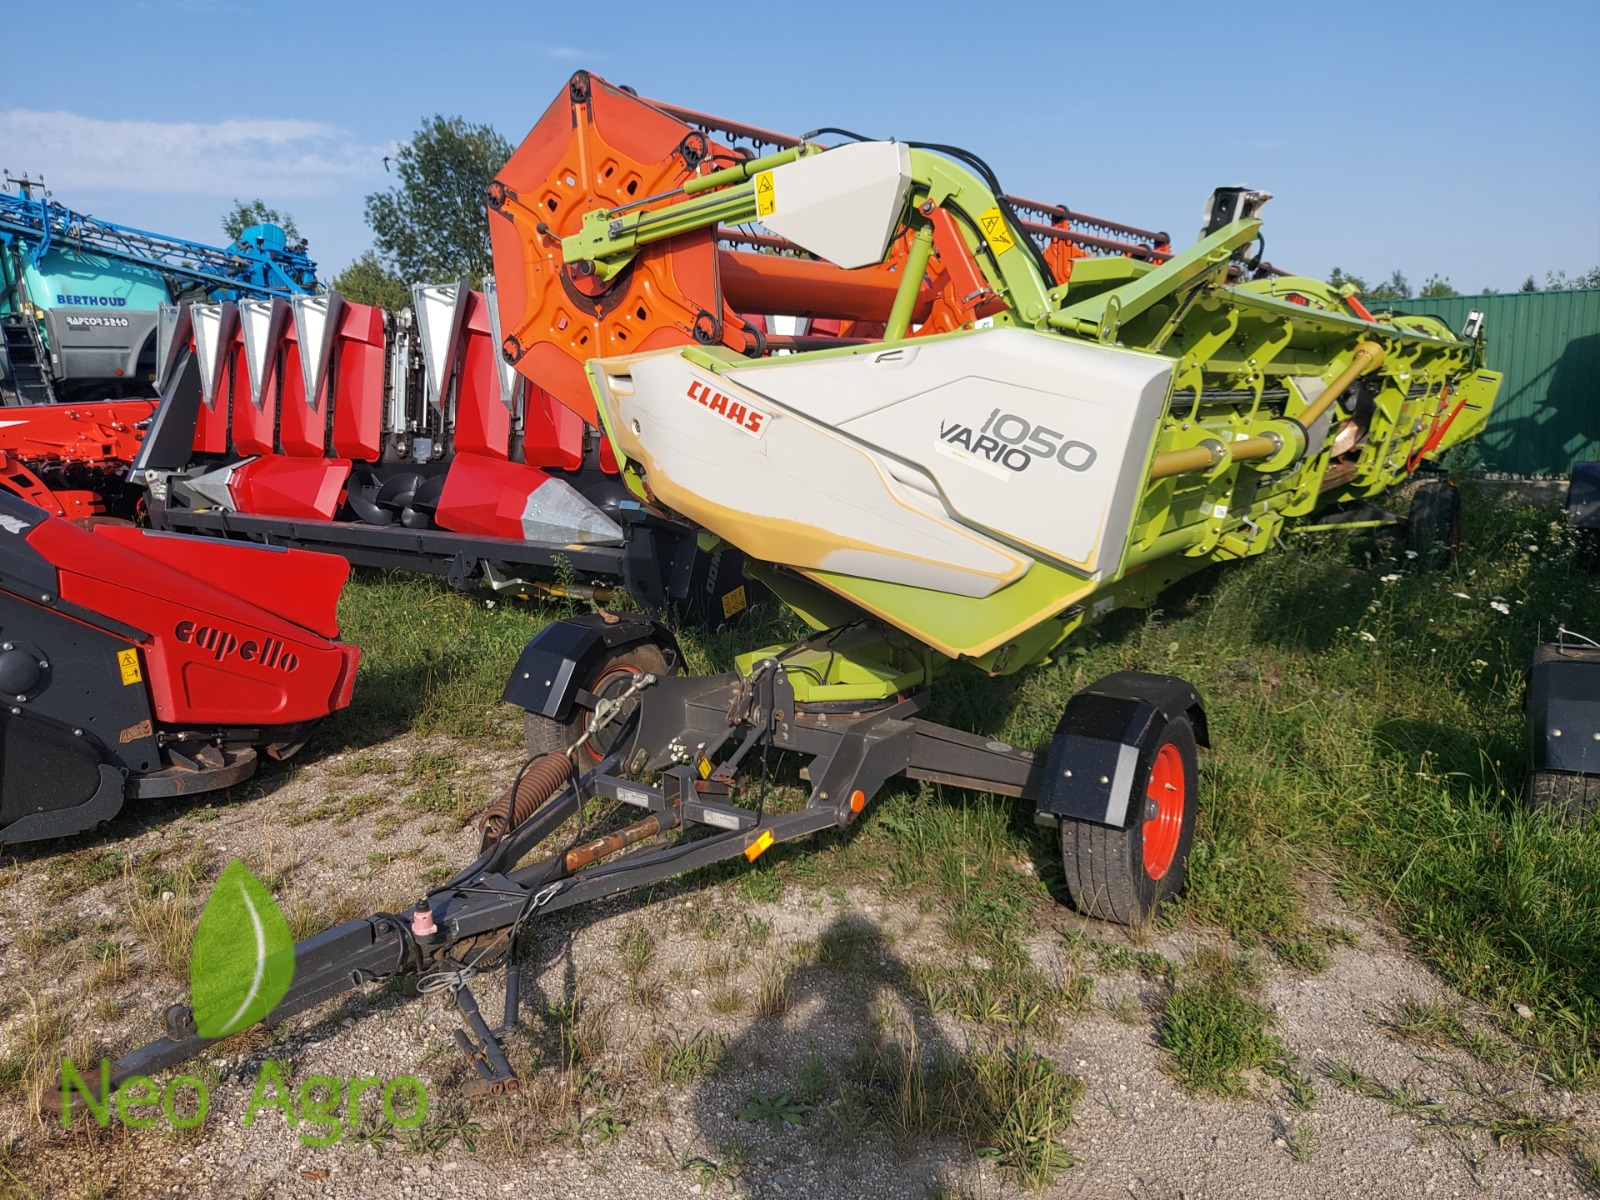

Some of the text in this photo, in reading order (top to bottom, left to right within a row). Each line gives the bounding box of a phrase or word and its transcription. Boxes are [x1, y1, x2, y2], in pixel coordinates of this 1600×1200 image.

[57, 294, 126, 307] BERTHOUD
[66, 316, 103, 326] RAPTOR
[686, 380, 764, 433] CLAAS
[940, 418, 1031, 472] VARIO
[980, 407, 1098, 472] 1050
